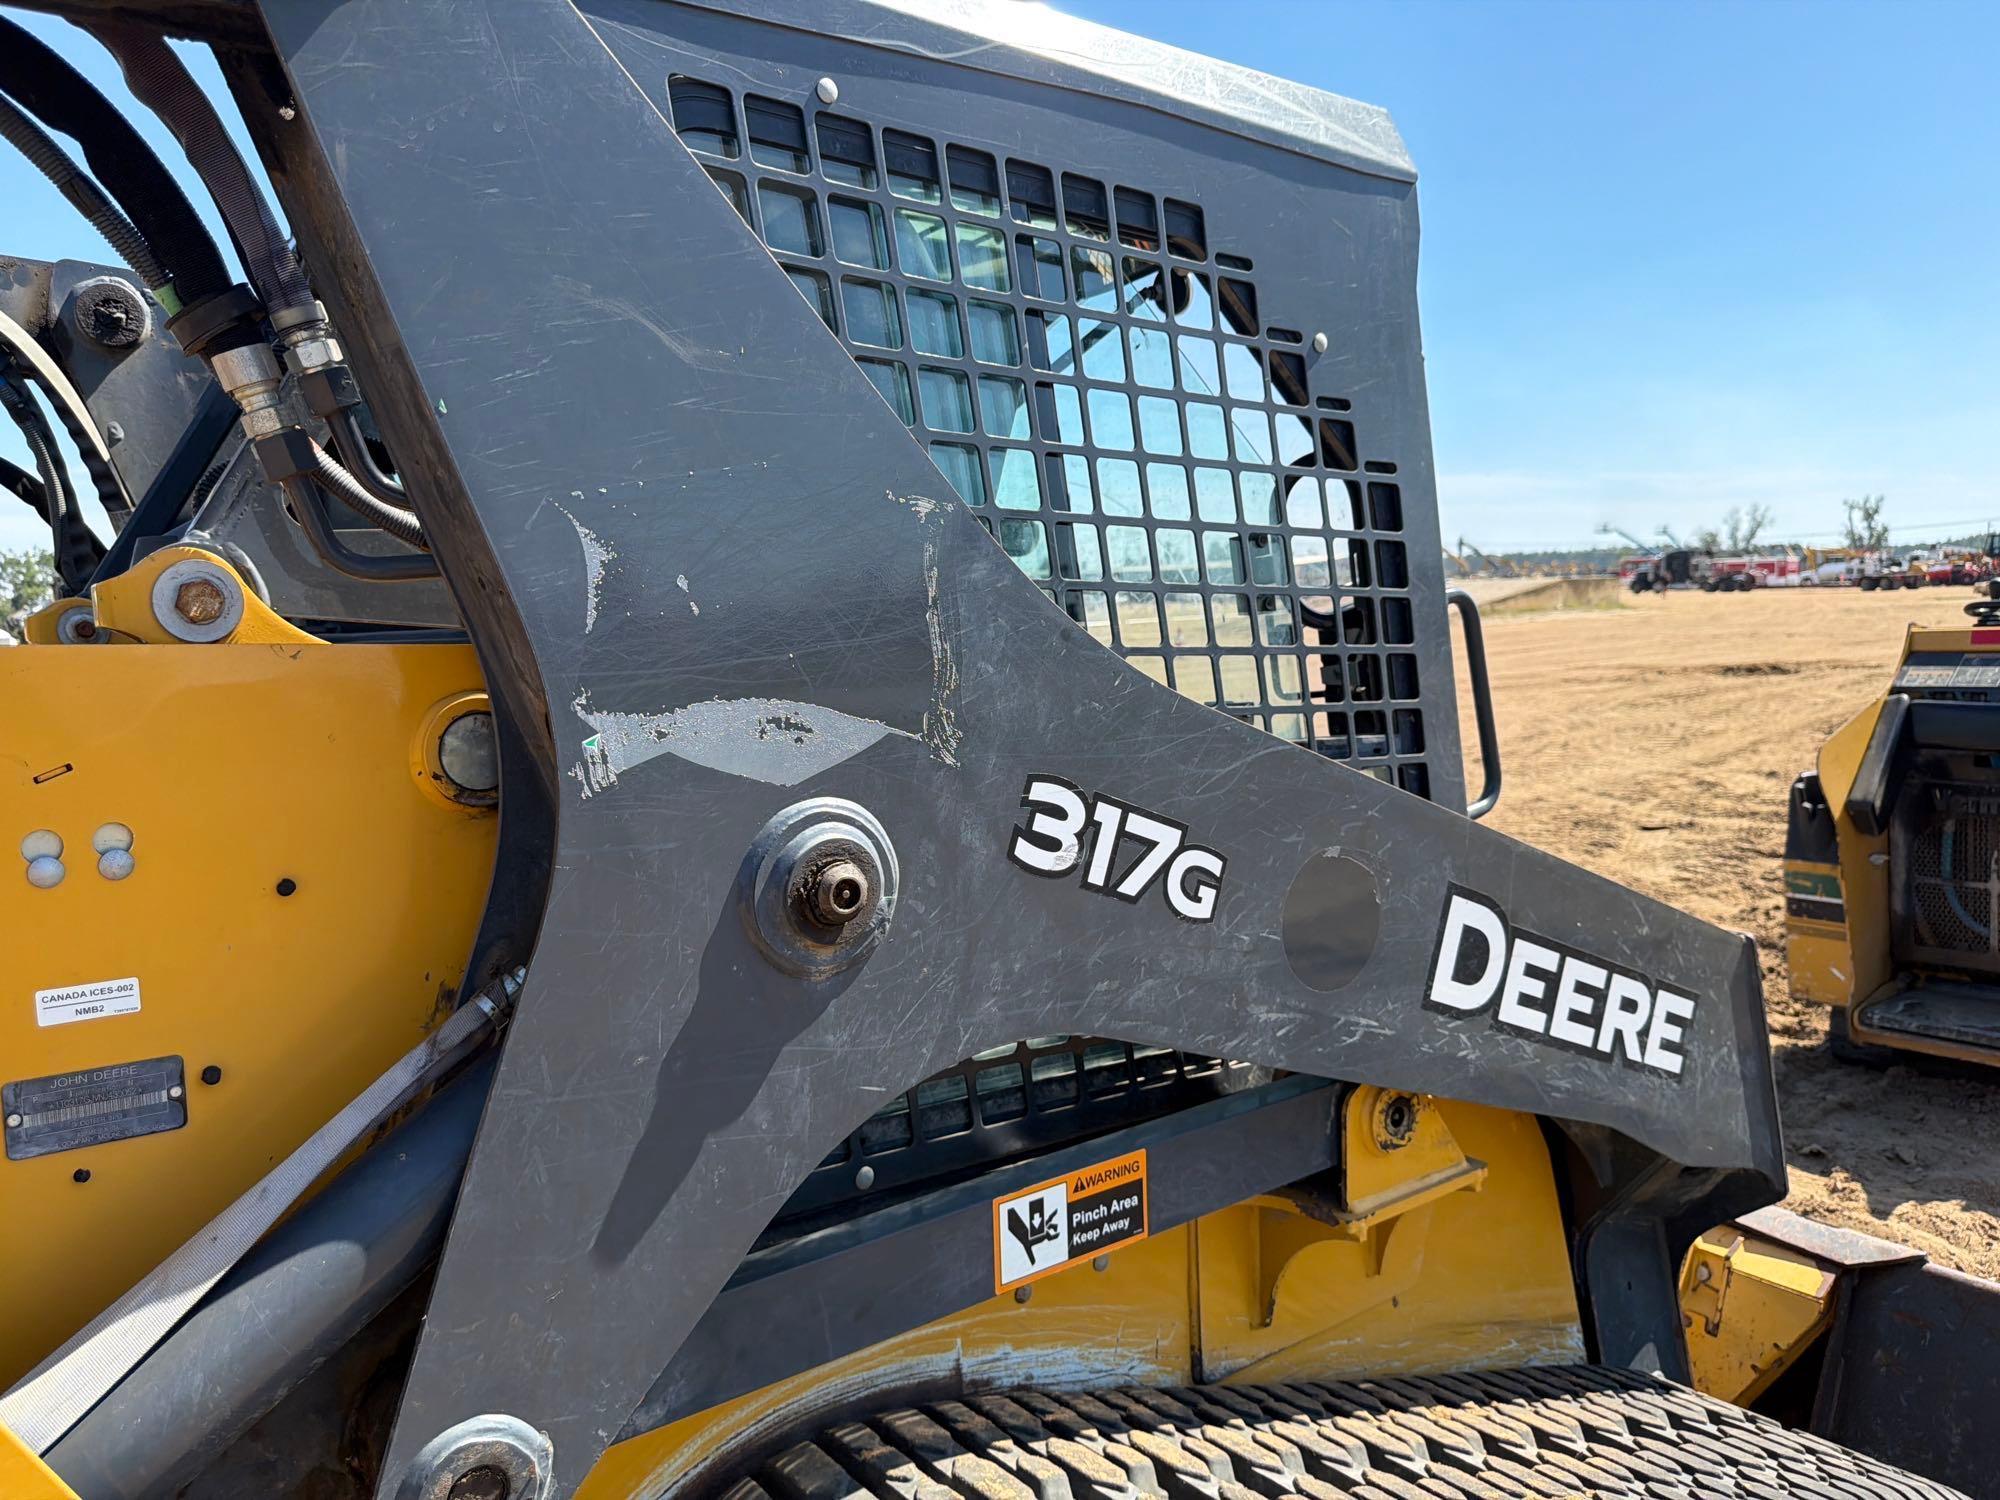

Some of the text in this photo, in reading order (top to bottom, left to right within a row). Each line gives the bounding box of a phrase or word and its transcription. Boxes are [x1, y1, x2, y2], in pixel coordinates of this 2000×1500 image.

[1012, 780, 1224, 920] 317G
[41, 983, 135, 1004] CANADA ICES-002
[1430, 894, 1696, 1075] DEERE
[75, 1004, 105, 1016] NMB2
[50, 1065, 138, 1089] JOHN DEERE
[1085, 1160, 1140, 1188] WARNING
[1072, 1195, 1139, 1227] Pinch Area
[1073, 1216, 1131, 1246] Keep Away
